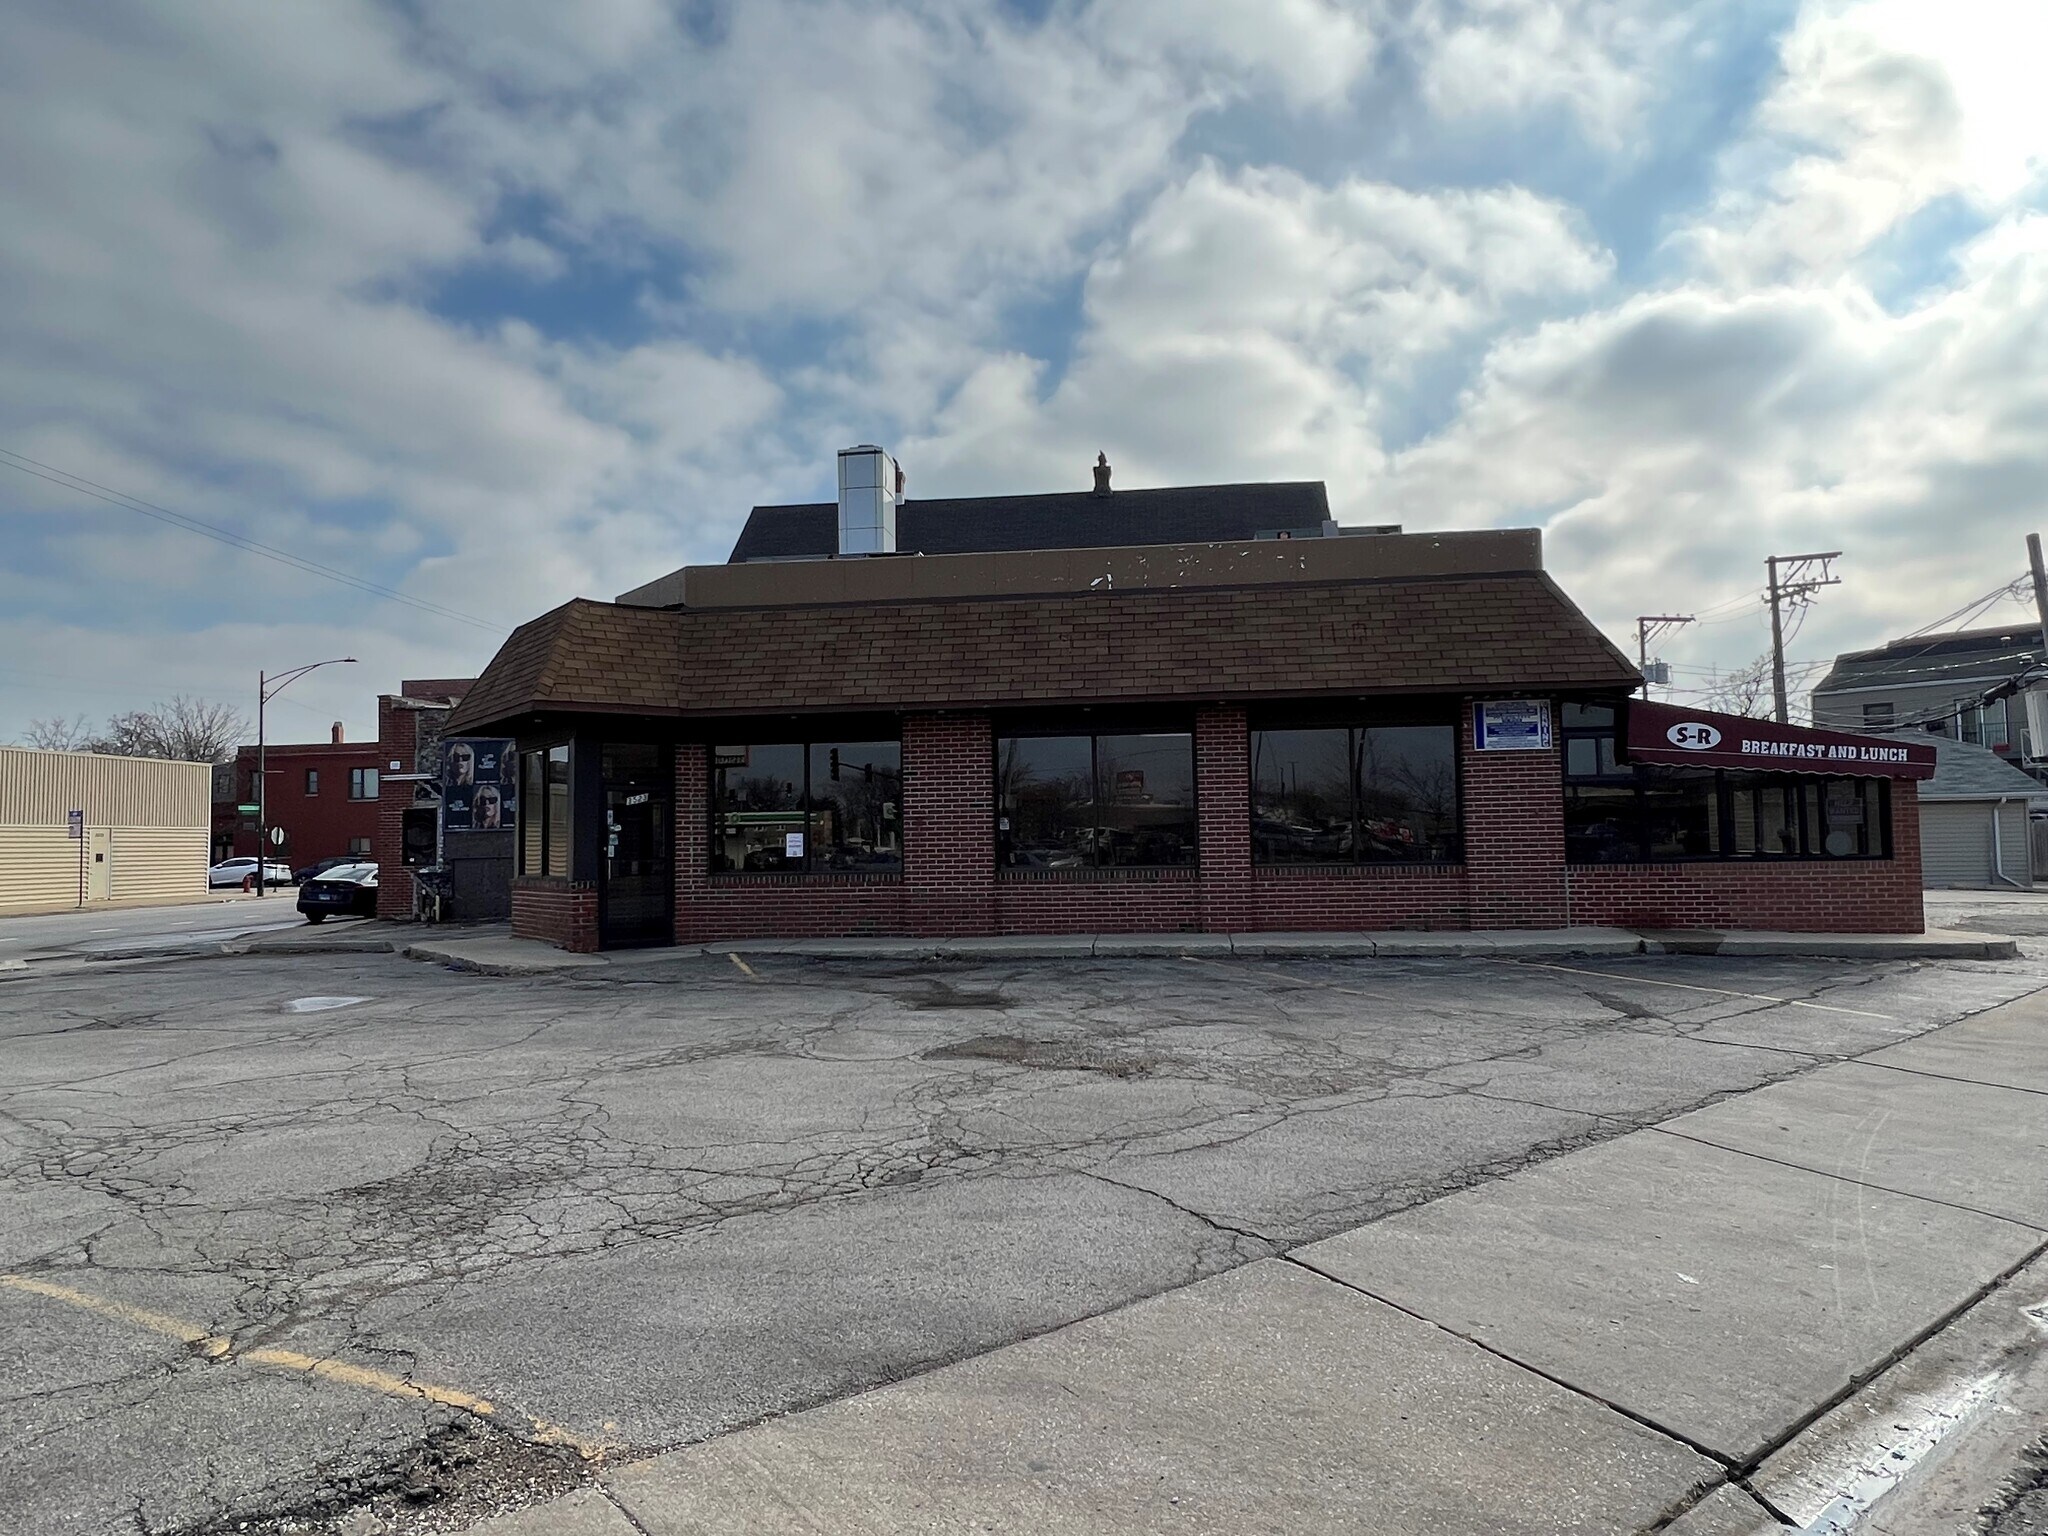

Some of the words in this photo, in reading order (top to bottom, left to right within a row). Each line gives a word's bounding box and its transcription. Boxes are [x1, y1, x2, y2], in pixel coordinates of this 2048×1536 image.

[1676, 727, 1711, 745] S-R
[1741, 739, 1826, 758] BREAKFAST
[1828, 745, 1857, 760] AND
[1860, 747, 1908, 762] LUNCH
